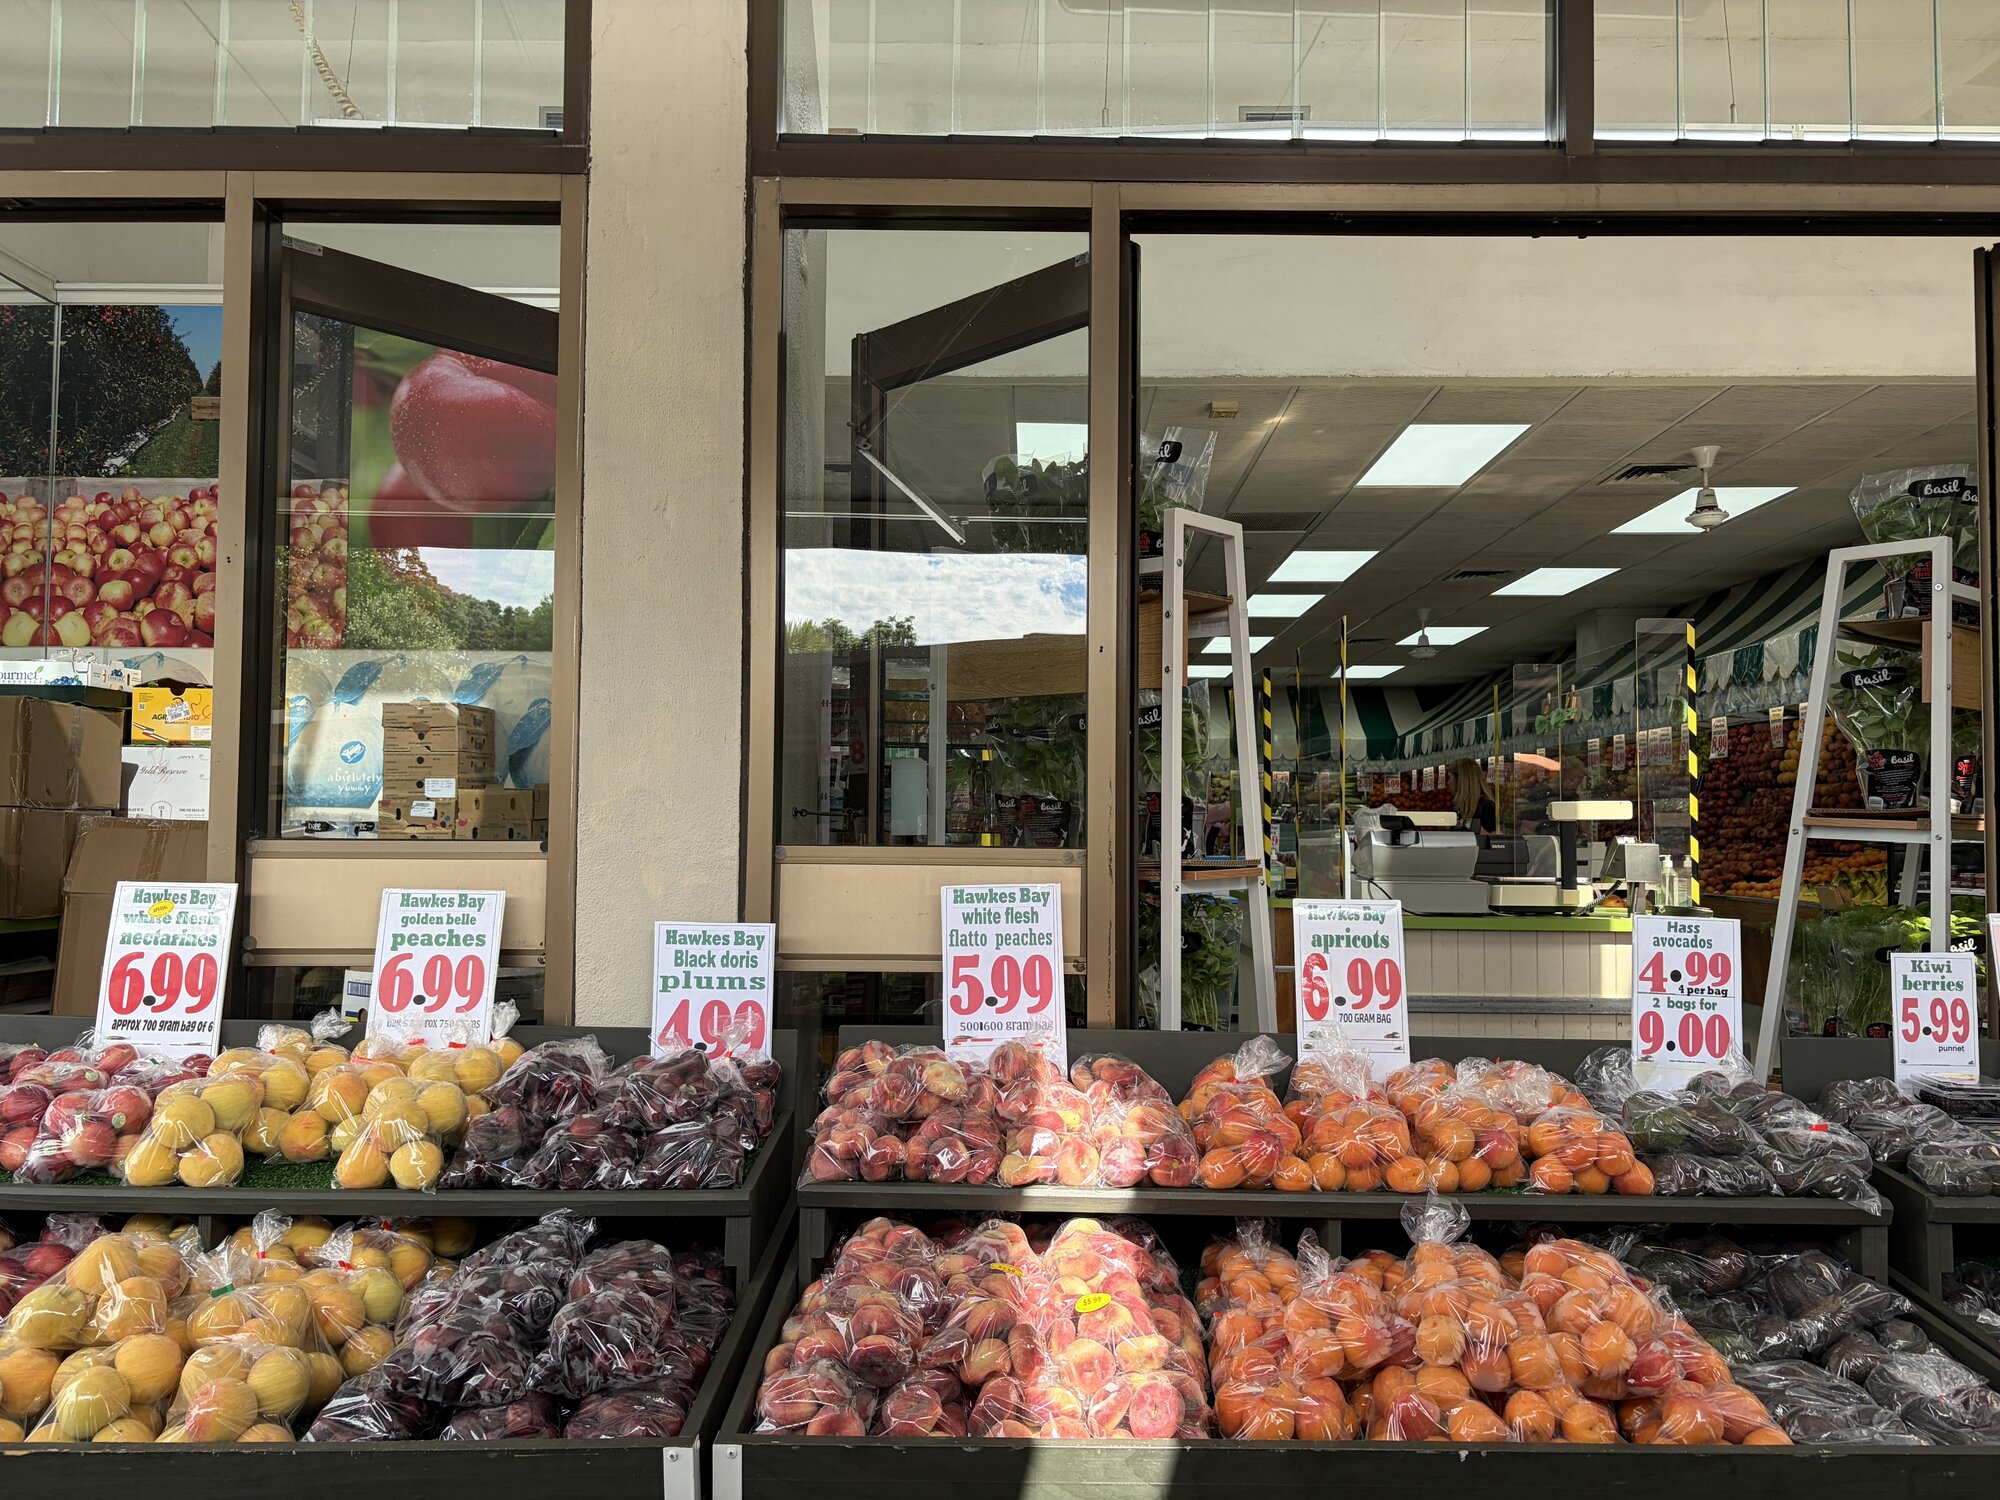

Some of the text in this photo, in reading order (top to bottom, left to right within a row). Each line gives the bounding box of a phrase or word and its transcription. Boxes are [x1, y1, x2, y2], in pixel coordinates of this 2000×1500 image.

[1924, 479, 1961, 495] Basil
[1854, 668, 1891, 686] Basil
[1138, 709, 1161, 725] asil
[1711, 735, 1727, 753] 8.99
[1890, 752, 1915, 765] Basil
[138, 765, 188, 775] Gold Reserve
[327, 771, 382, 785] absolutely
[338, 785, 371, 795] yummy
[1040, 802, 1063, 811] Basil
[132, 888, 217, 909] Hawkes Bay
[400, 893, 485, 912] Hawkes Bay
[953, 887, 1051, 907] Hawkes Bay
[401, 913, 477, 927] golden belle
[962, 906, 1039, 925] white flesh
[1362, 906, 1386, 924] Bay
[1667, 921, 1700, 934] Hass
[119, 929, 218, 947] nectarines
[390, 929, 486, 951] peaches
[666, 929, 765, 950] Hawkes Bay
[949, 928, 1053, 950] flatto peaches
[1311, 927, 1390, 953] apricots
[1653, 934, 1713, 949] avocados
[1950, 937, 1977, 953] asil
[674, 950, 759, 968] Black doris
[1910, 960, 1952, 973] Kiwi
[1638, 951, 1731, 992] 4.99
[108, 952, 218, 1015] 6.99
[378, 952, 485, 1013] 6.99
[659, 970, 766, 993] plums
[950, 954, 1053, 1015] 5.99
[1302, 952, 1402, 1021] 6.99
[1902, 974, 1964, 992] berries
[1678, 985, 1728, 997] 4 per bag
[1652, 997, 1717, 1012] 2 bags for
[111, 1019, 142, 1031] approx
[143, 1019, 157, 1031] 700
[158, 1020, 180, 1032] gram
[180, 1020, 195, 1032] bag
[207, 1021, 214, 1033] 6
[1339, 1013, 1392, 1024] 700 GRAM BAG
[1901, 997, 1970, 1044] 5.99
[658, 999, 766, 1060] 4.99
[1639, 1010, 1731, 1059] 9.00
[1938, 1045, 1964, 1053] punnet
